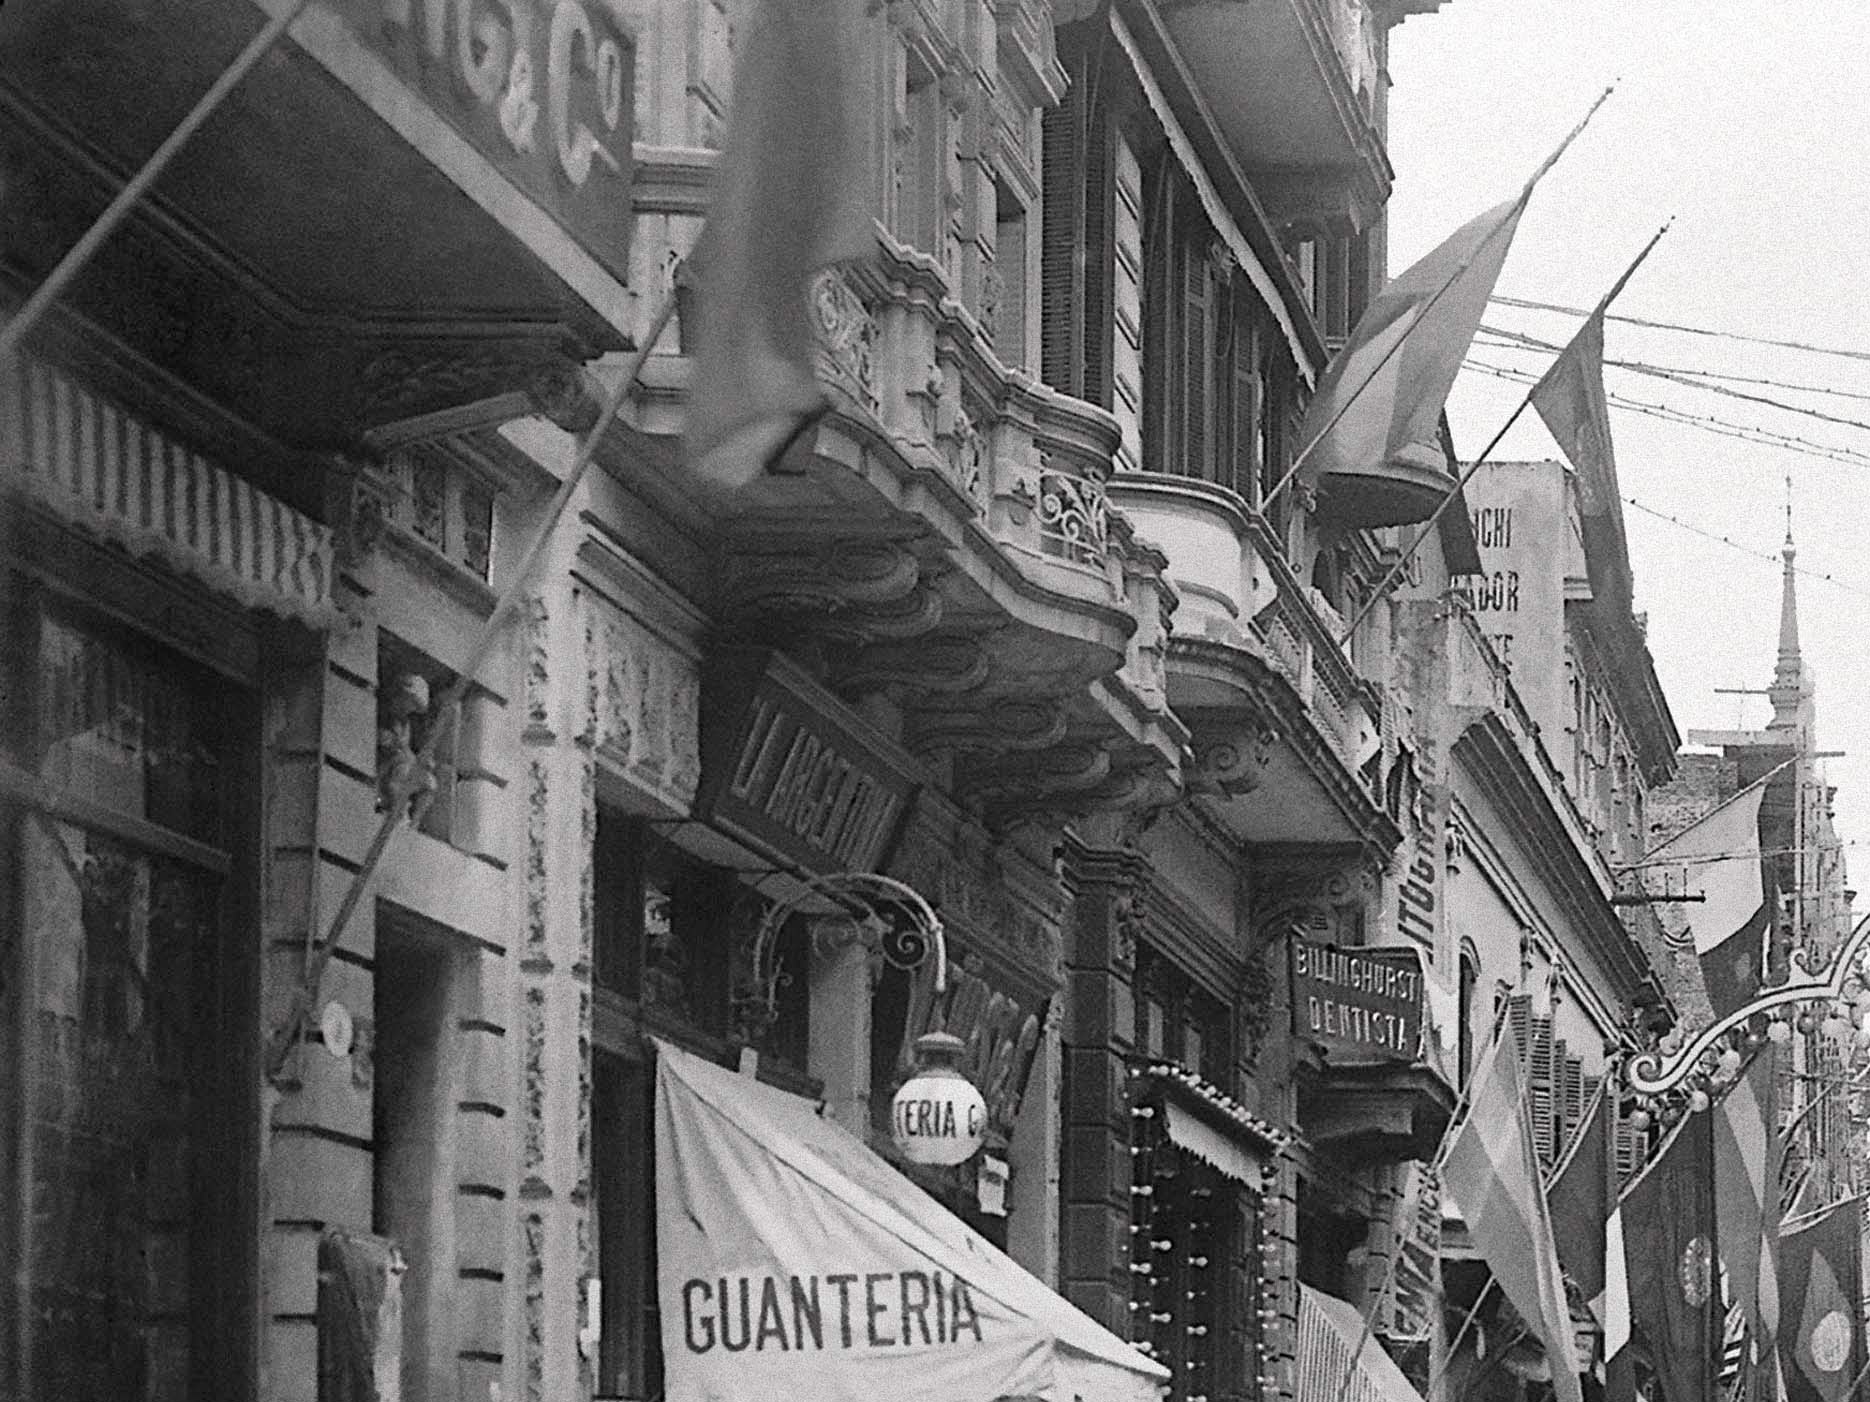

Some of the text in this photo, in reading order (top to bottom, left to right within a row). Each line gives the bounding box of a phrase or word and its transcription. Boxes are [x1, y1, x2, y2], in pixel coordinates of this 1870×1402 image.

[1296, 944, 1417, 1003] BILLINGHURST
[1308, 995, 1408, 1051] DENTISTA
[681, 1269, 983, 1355] GUANTERIA
